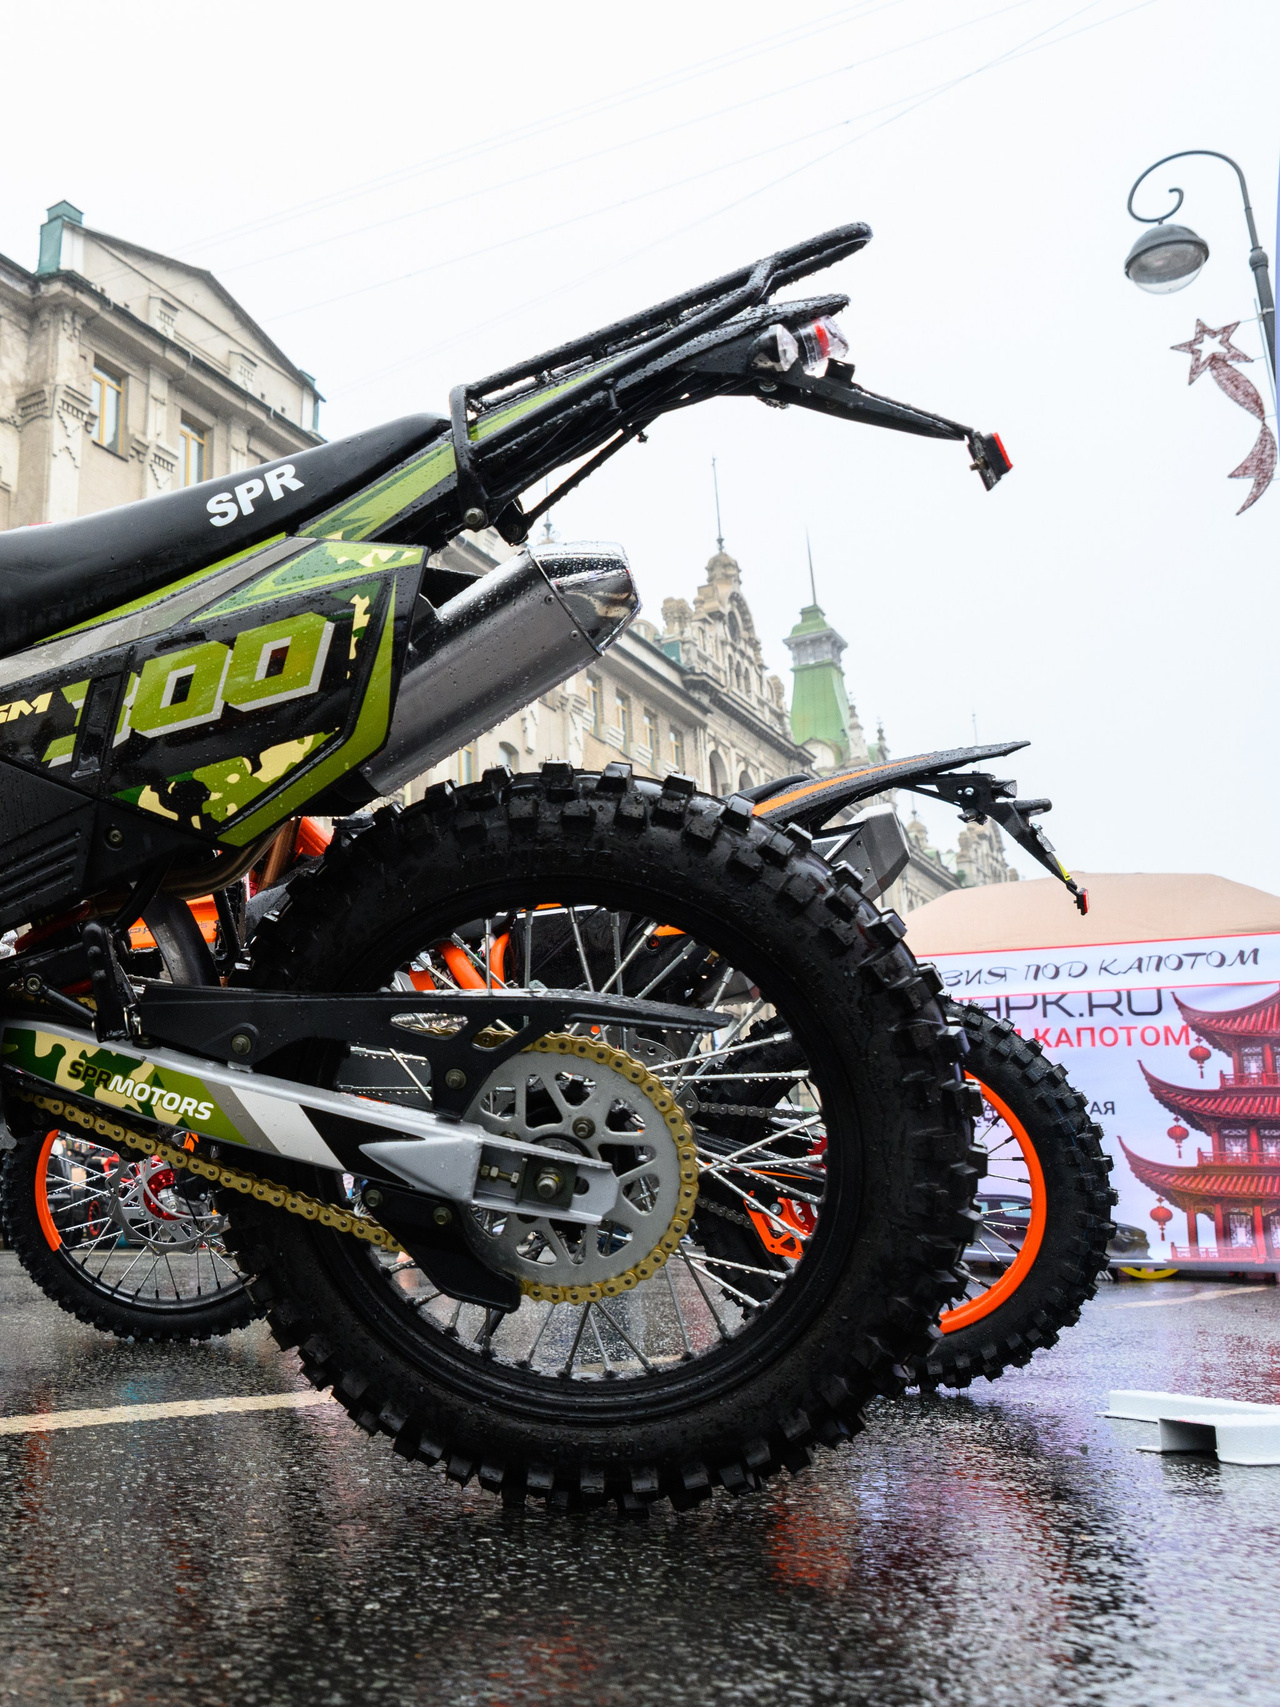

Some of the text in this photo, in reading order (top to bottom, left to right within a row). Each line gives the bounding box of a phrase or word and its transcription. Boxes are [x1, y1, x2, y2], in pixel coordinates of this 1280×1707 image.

[206, 463, 304, 527] SPR
[1024, 961, 1088, 981] ПОД
[1098, 948, 1259, 976] КАПОТОМ
[1034, 1025, 1190, 1048] КАПОТОМ
[67, 1060, 214, 1121] SPRMOTORS
